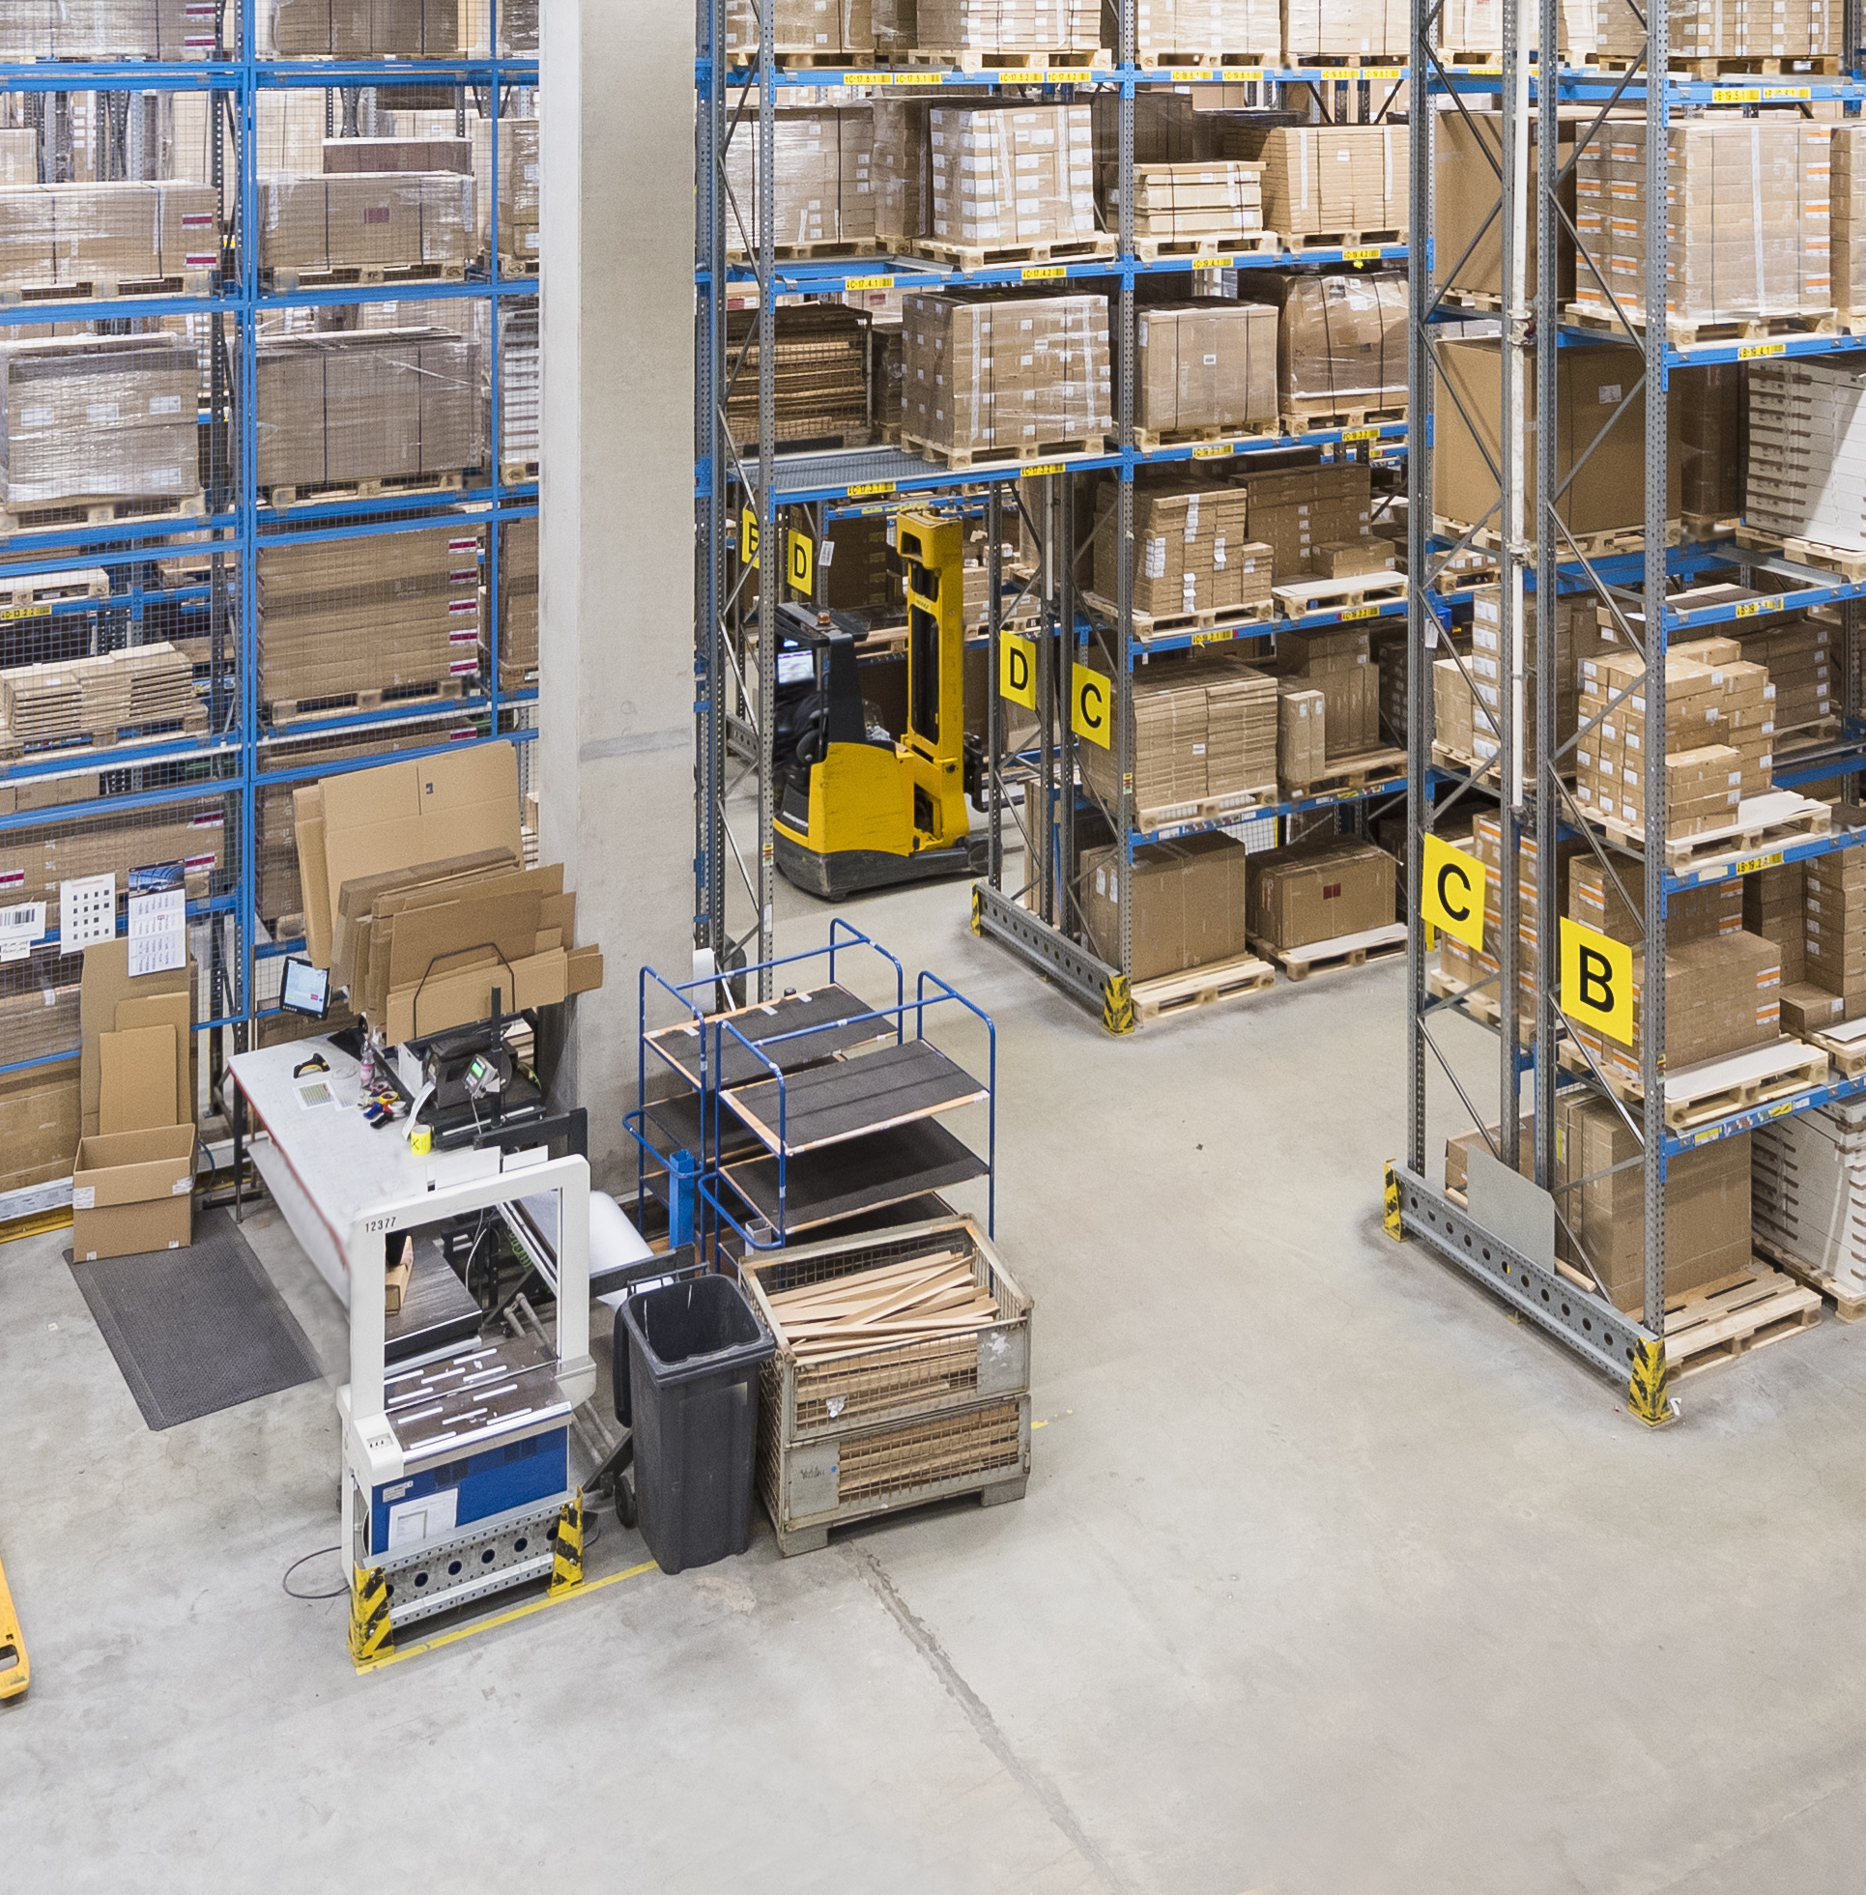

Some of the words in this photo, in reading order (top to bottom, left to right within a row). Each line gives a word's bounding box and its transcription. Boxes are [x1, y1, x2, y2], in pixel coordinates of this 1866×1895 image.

[794, 543, 807, 579] D
[1011, 647, 1029, 691] D
[1080, 683, 1102, 729] C
[1437, 863, 1471, 922] C
[1579, 944, 1614, 1013] B
[364, 1216, 397, 1233] 12377
